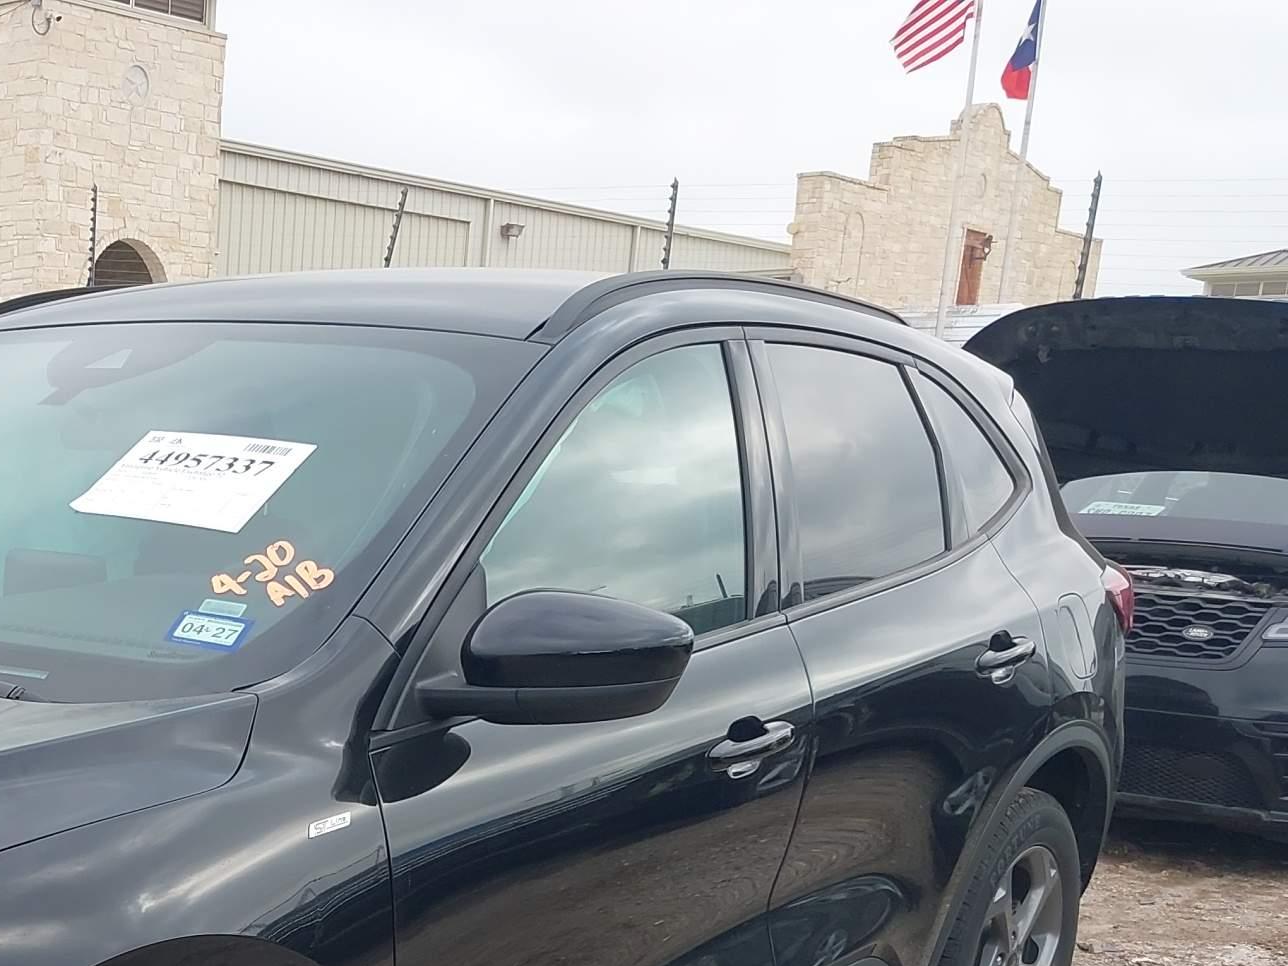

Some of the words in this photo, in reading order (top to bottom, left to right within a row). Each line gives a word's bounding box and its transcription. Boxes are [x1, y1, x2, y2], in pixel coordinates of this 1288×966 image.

[139, 449, 277, 477] 44957337
[211, 540, 296, 595] 4-20
[181, 622, 205, 635] 04
[211, 627, 239, 640] 27
